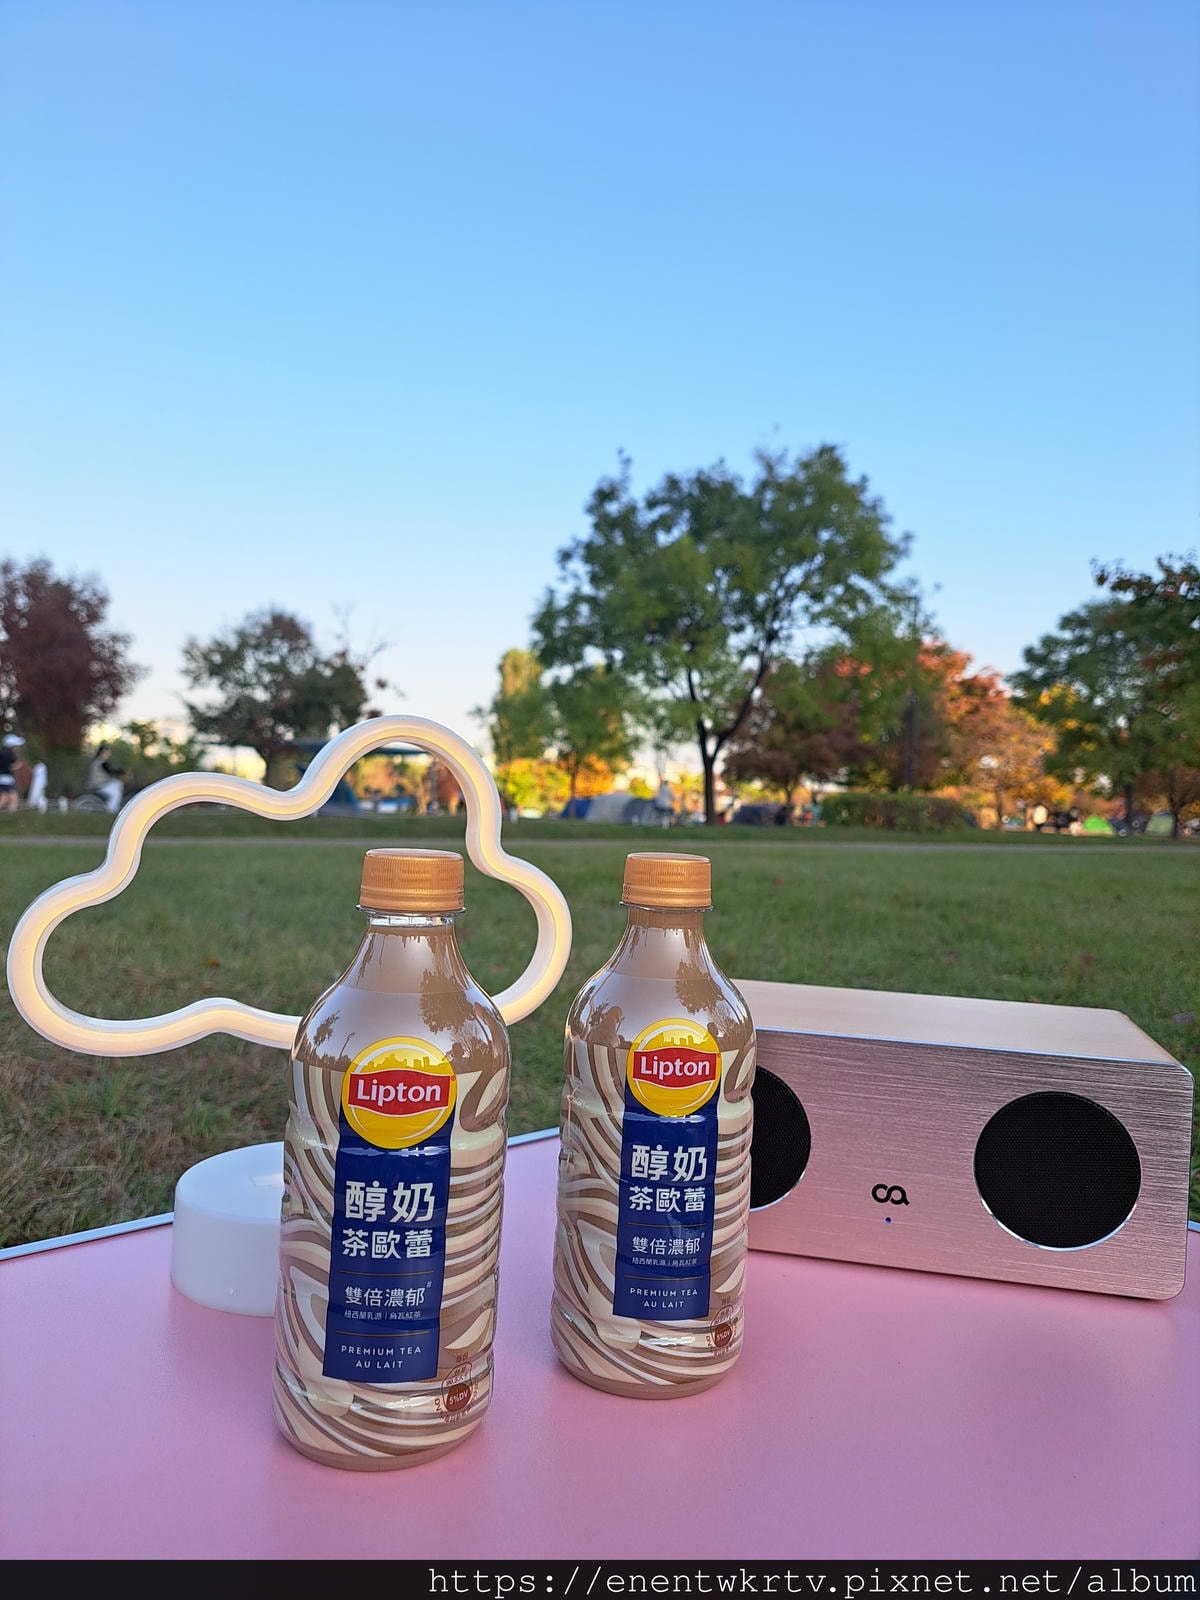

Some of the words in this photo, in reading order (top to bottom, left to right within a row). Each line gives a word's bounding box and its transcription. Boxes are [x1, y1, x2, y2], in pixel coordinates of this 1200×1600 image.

[640, 1055, 710, 1080] Lipton
[357, 1079, 441, 1107] Lipton
[631, 1144, 707, 1182] 醇奶
[345, 1180, 435, 1223] 醇奶
[629, 1185, 706, 1213] 茶歐蕾
[342, 1228, 433, 1260] 茶歐蕾
[630, 1287, 676, 1297] PREMIUM
[341, 1345, 394, 1356] PREMIUM
[400, 1346, 422, 1355] TEA
[355, 1360, 371, 1369] AU
[376, 1360, 404, 1369] LAIT
